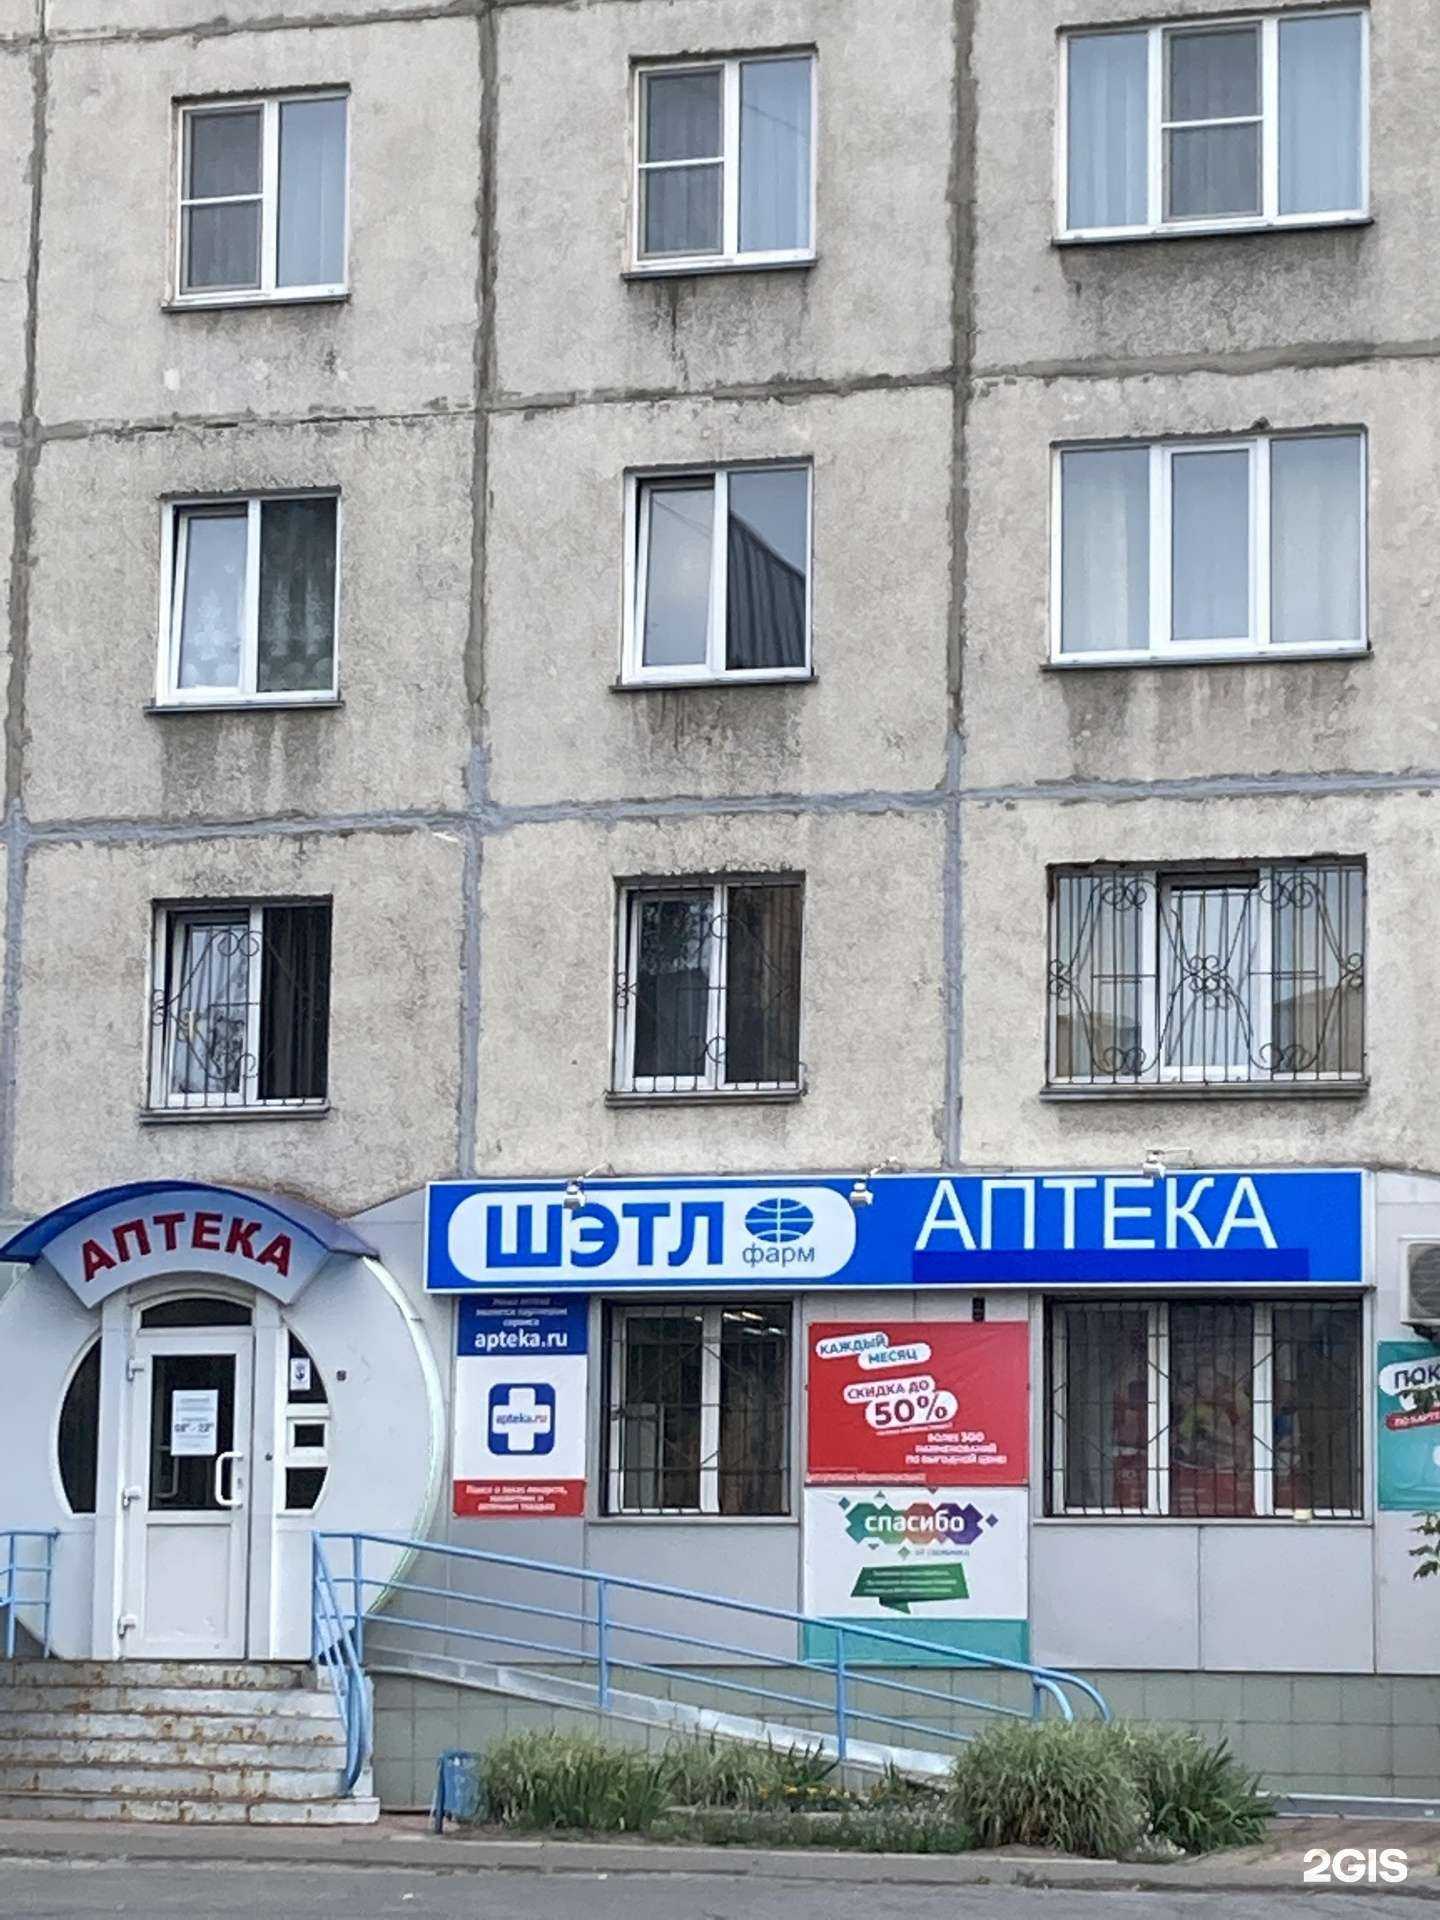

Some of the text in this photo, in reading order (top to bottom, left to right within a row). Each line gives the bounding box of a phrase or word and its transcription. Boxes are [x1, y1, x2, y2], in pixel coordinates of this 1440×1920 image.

[914, 1177, 1279, 1250] АПТЕКА
[82, 1211, 294, 1282] АПТЕКА
[486, 1201, 724, 1268] ШЭТЛ
[742, 1243, 816, 1268] фарм
[475, 1328, 568, 1352] apteka.ru
[820, 1334, 886, 1354] КАЖДЫЙ
[868, 1349, 918, 1364] МЕСЯЦ
[847, 1380, 930, 1399] СКИДКА ДО
[875, 1393, 948, 1425] 50%
[864, 1509, 966, 1532] спасибо
